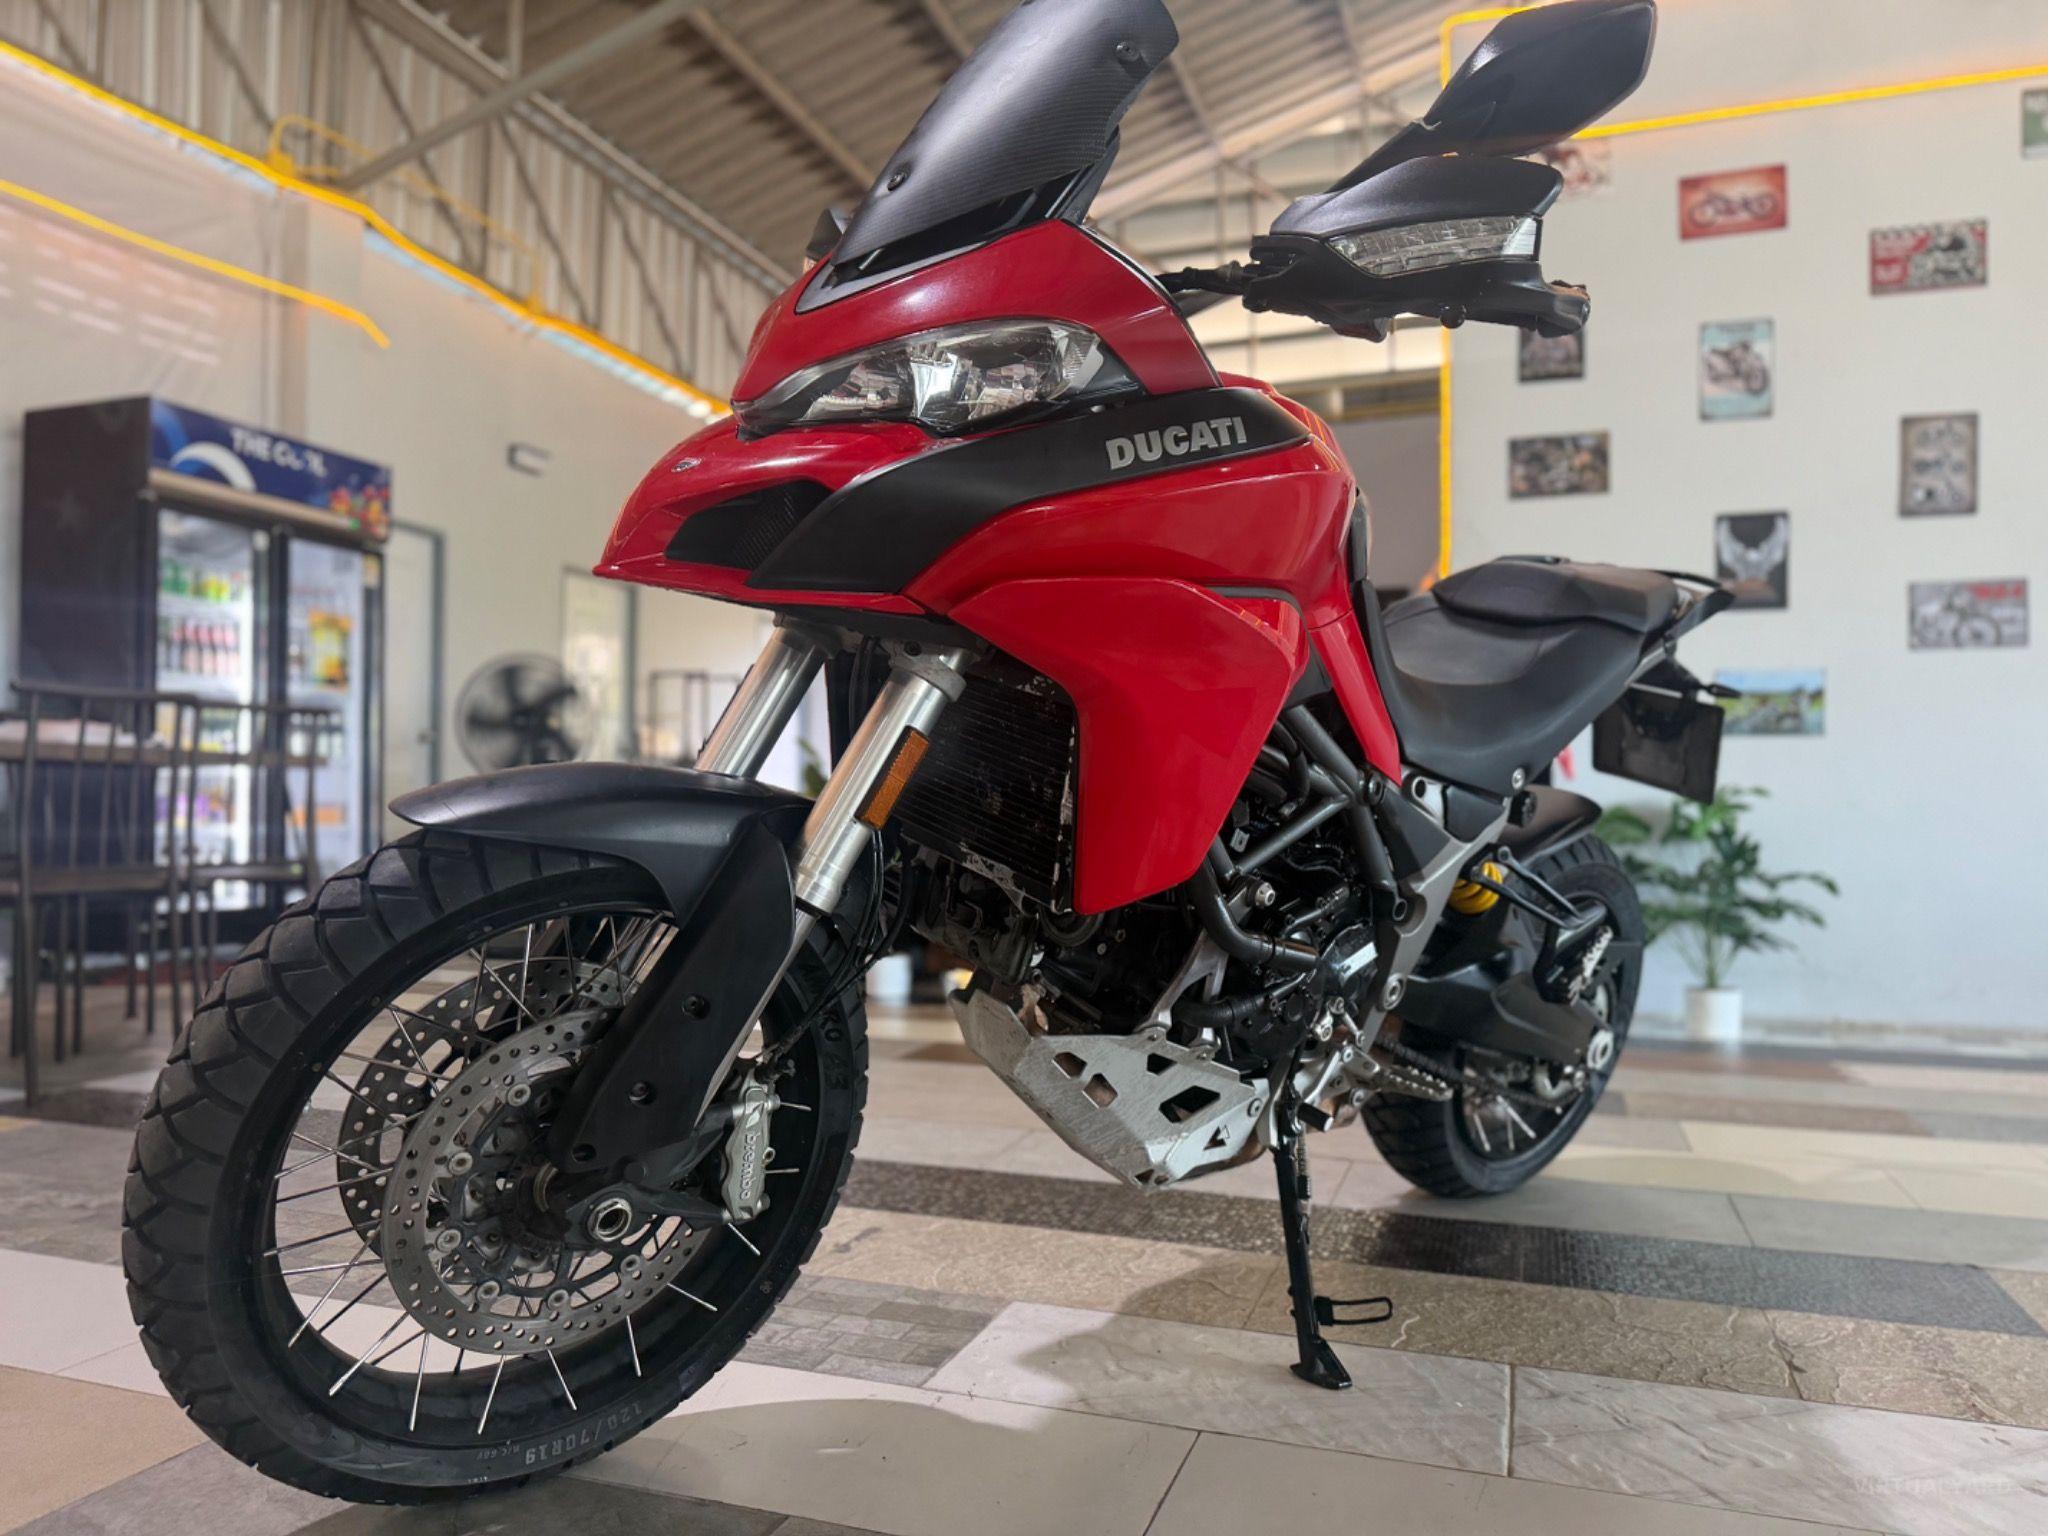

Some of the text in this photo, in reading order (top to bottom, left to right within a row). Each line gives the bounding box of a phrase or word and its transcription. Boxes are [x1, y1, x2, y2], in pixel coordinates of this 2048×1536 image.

[1105, 416, 1247, 470] DUCATI
[740, 1132, 761, 1200] brembo
[524, 1400, 643, 1466] 120/70R19
